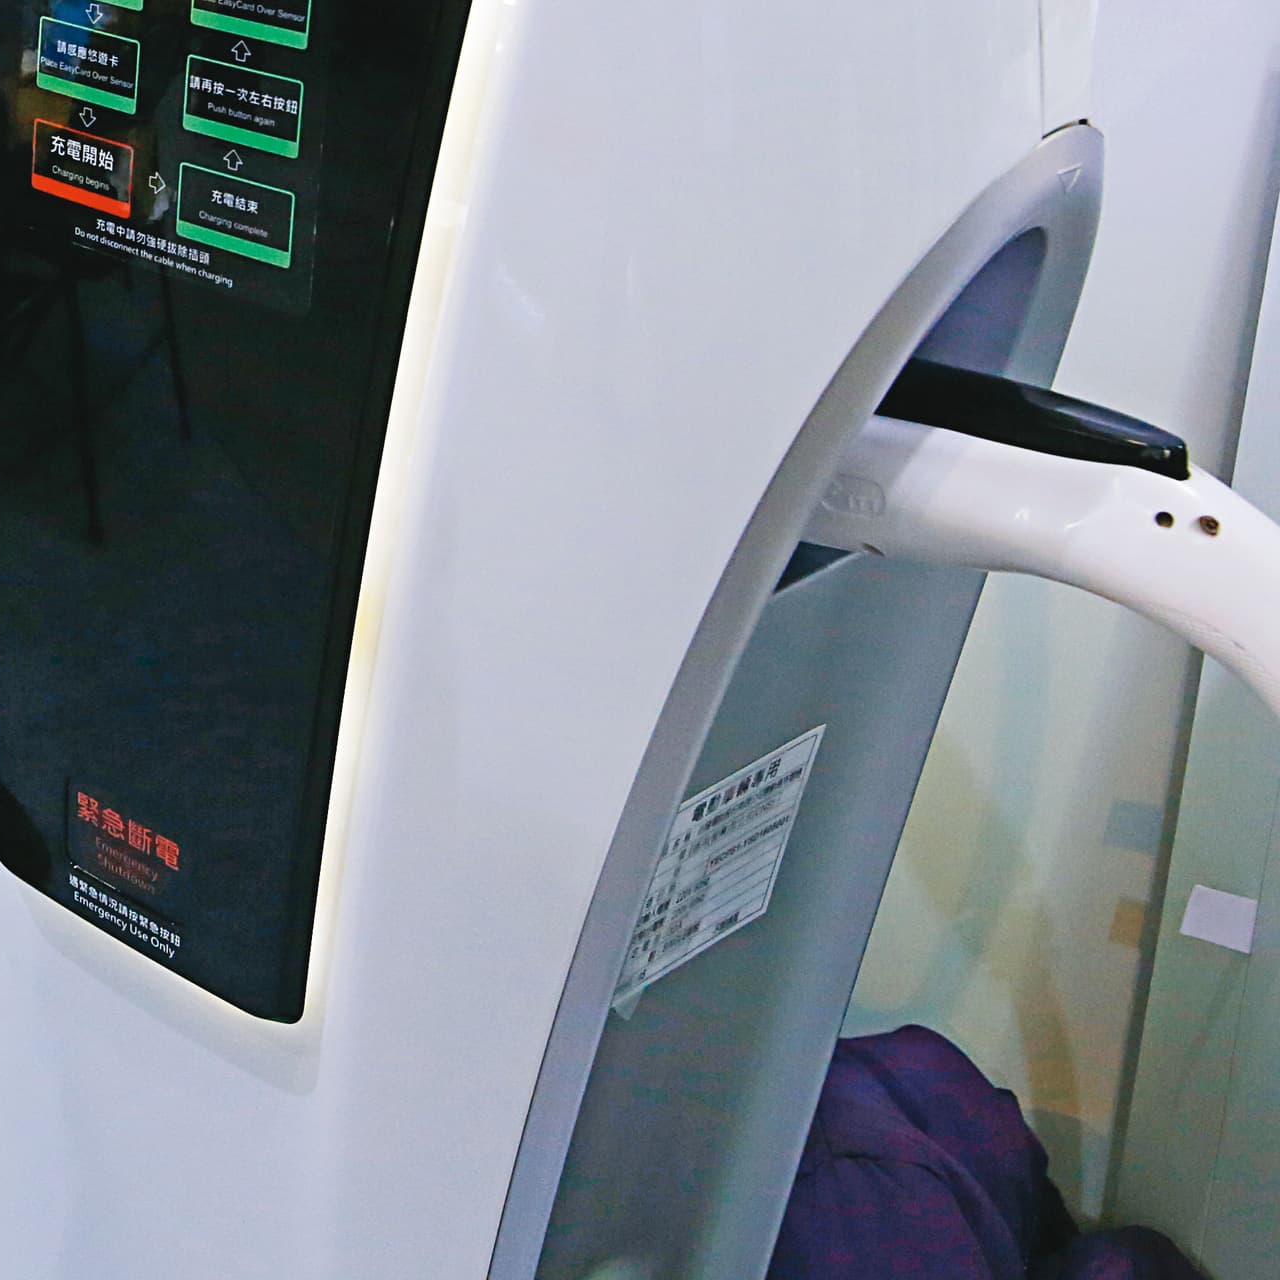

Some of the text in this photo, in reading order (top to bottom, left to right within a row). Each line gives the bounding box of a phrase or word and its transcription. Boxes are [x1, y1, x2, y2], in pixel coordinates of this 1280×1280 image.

[256, 4, 276, 16] Over
[277, 9, 306, 22] Sensor
[57, 40, 119, 68] 請感應悠遊卡
[41, 56, 135, 90] Place EasyCard Over Sensor
[189, 75, 298, 115] 請再按一次左右按鈕
[207, 102, 276, 127] Push button again
[50, 135, 114, 172] 充電開始
[52, 164, 110, 191] Charging begins
[211, 190, 259, 214] 充電結束
[199, 210, 268, 238] Charging complete
[74, 226, 234, 289] Do not disconnect the cable when charging
[77, 791, 180, 872] 緊急斷電
[74, 890, 176, 959] Emergency Use Only
